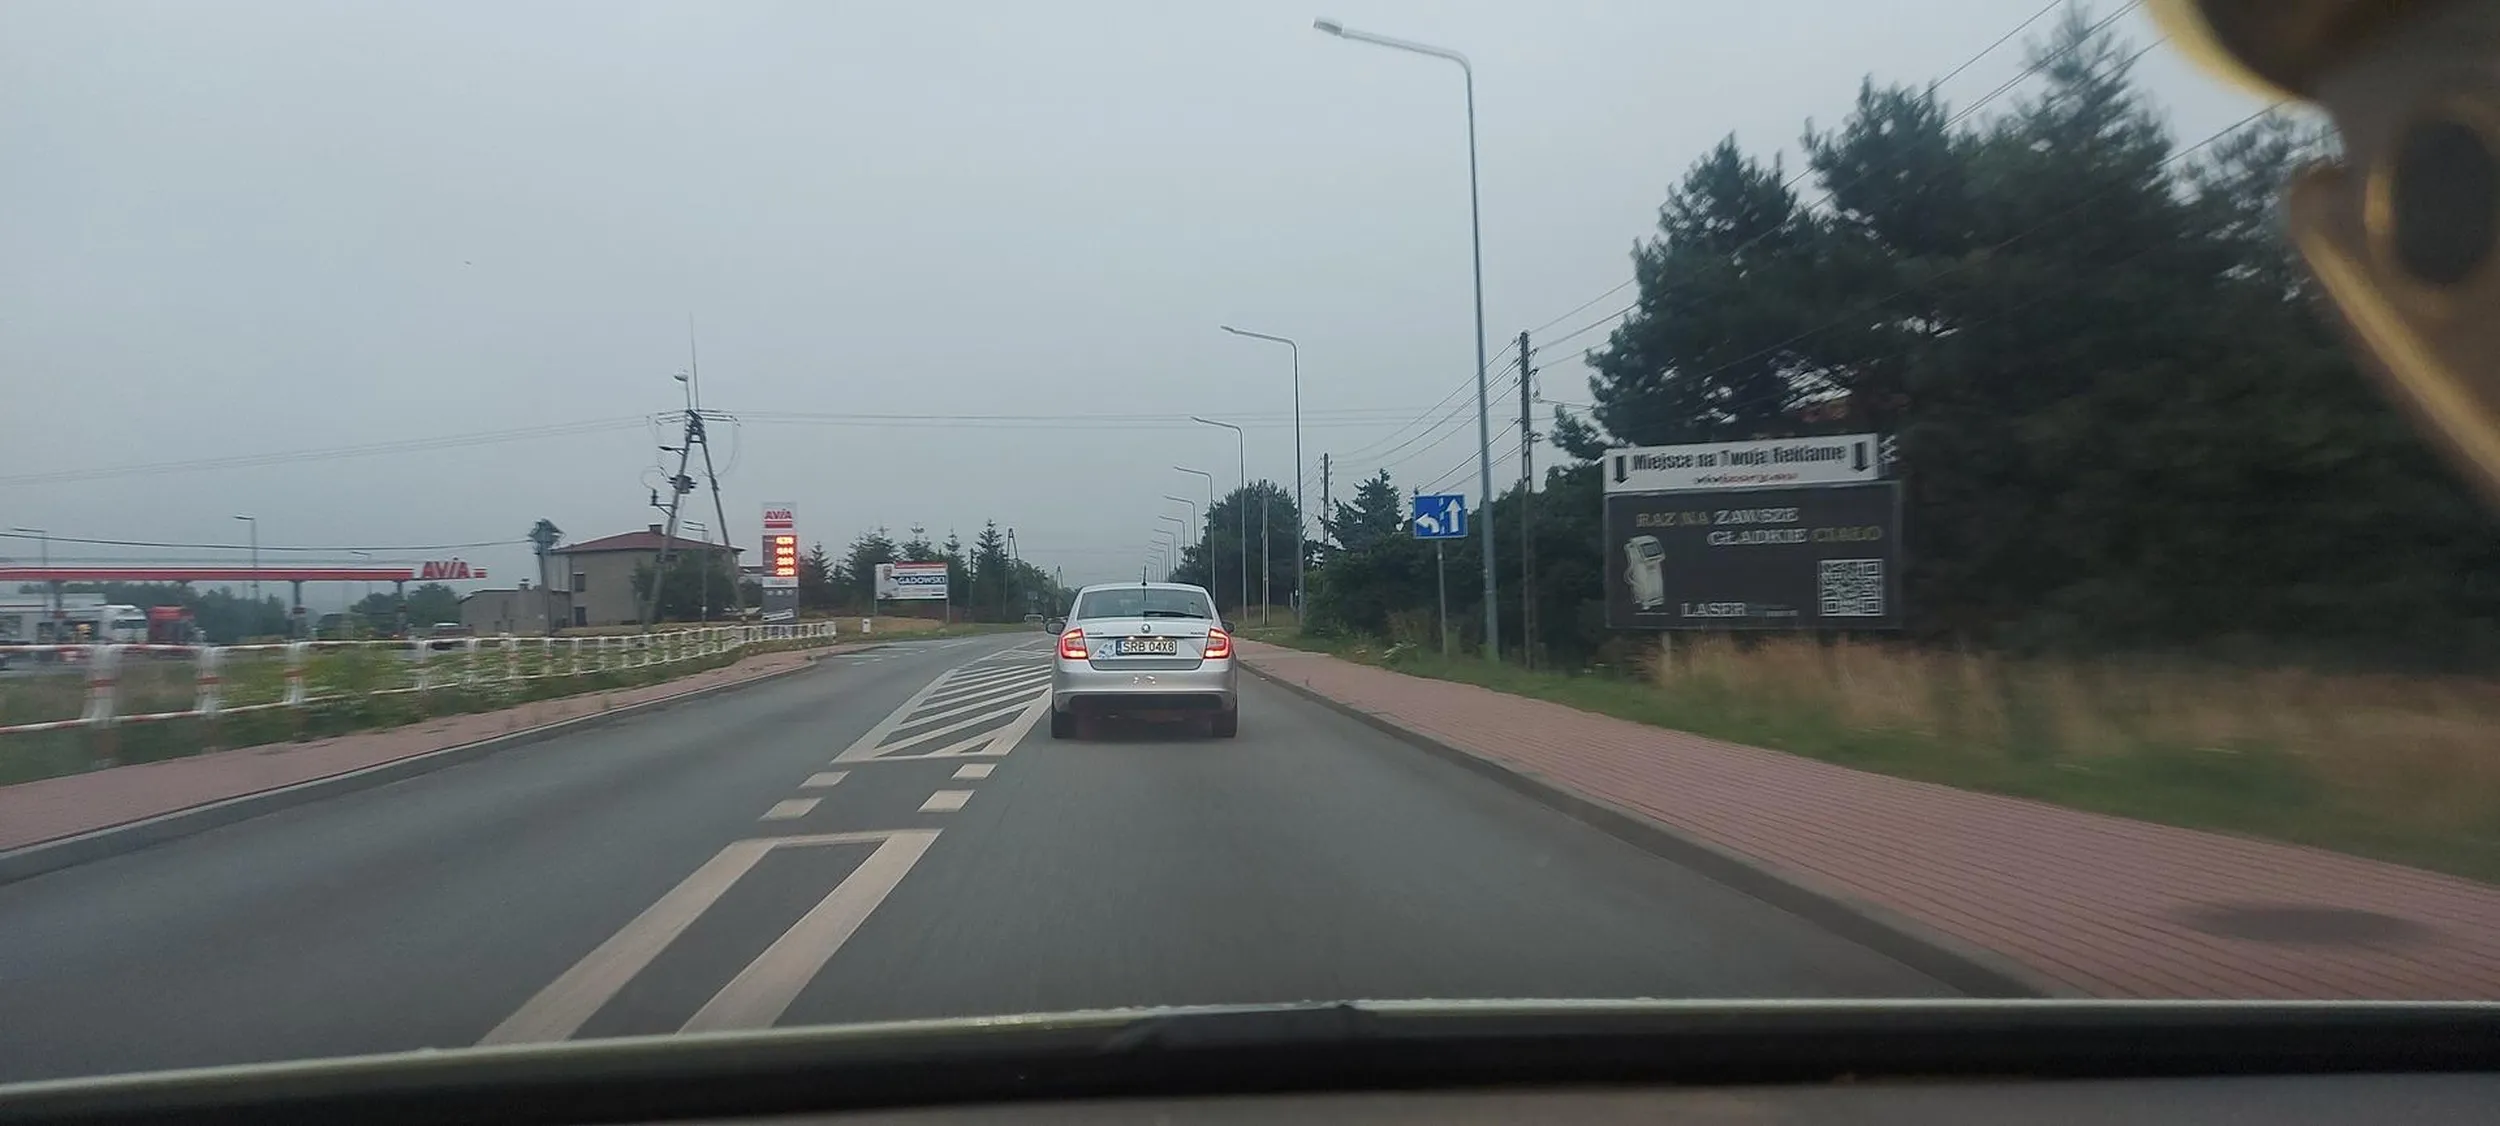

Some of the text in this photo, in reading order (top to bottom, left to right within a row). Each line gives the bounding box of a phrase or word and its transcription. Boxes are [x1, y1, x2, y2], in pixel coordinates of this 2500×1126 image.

[1633, 454, 1694, 472] Miejsce
[1698, 453, 1718, 468] na
[764, 508, 793, 519] AVIA
[1636, 512, 1677, 527] RAZ
[1713, 508, 1800, 525] ZAWSZE
[422, 557, 471, 579] AVIA
[1680, 602, 1748, 618] LASER
[1123, 641, 1174, 652] SRB 04X8
